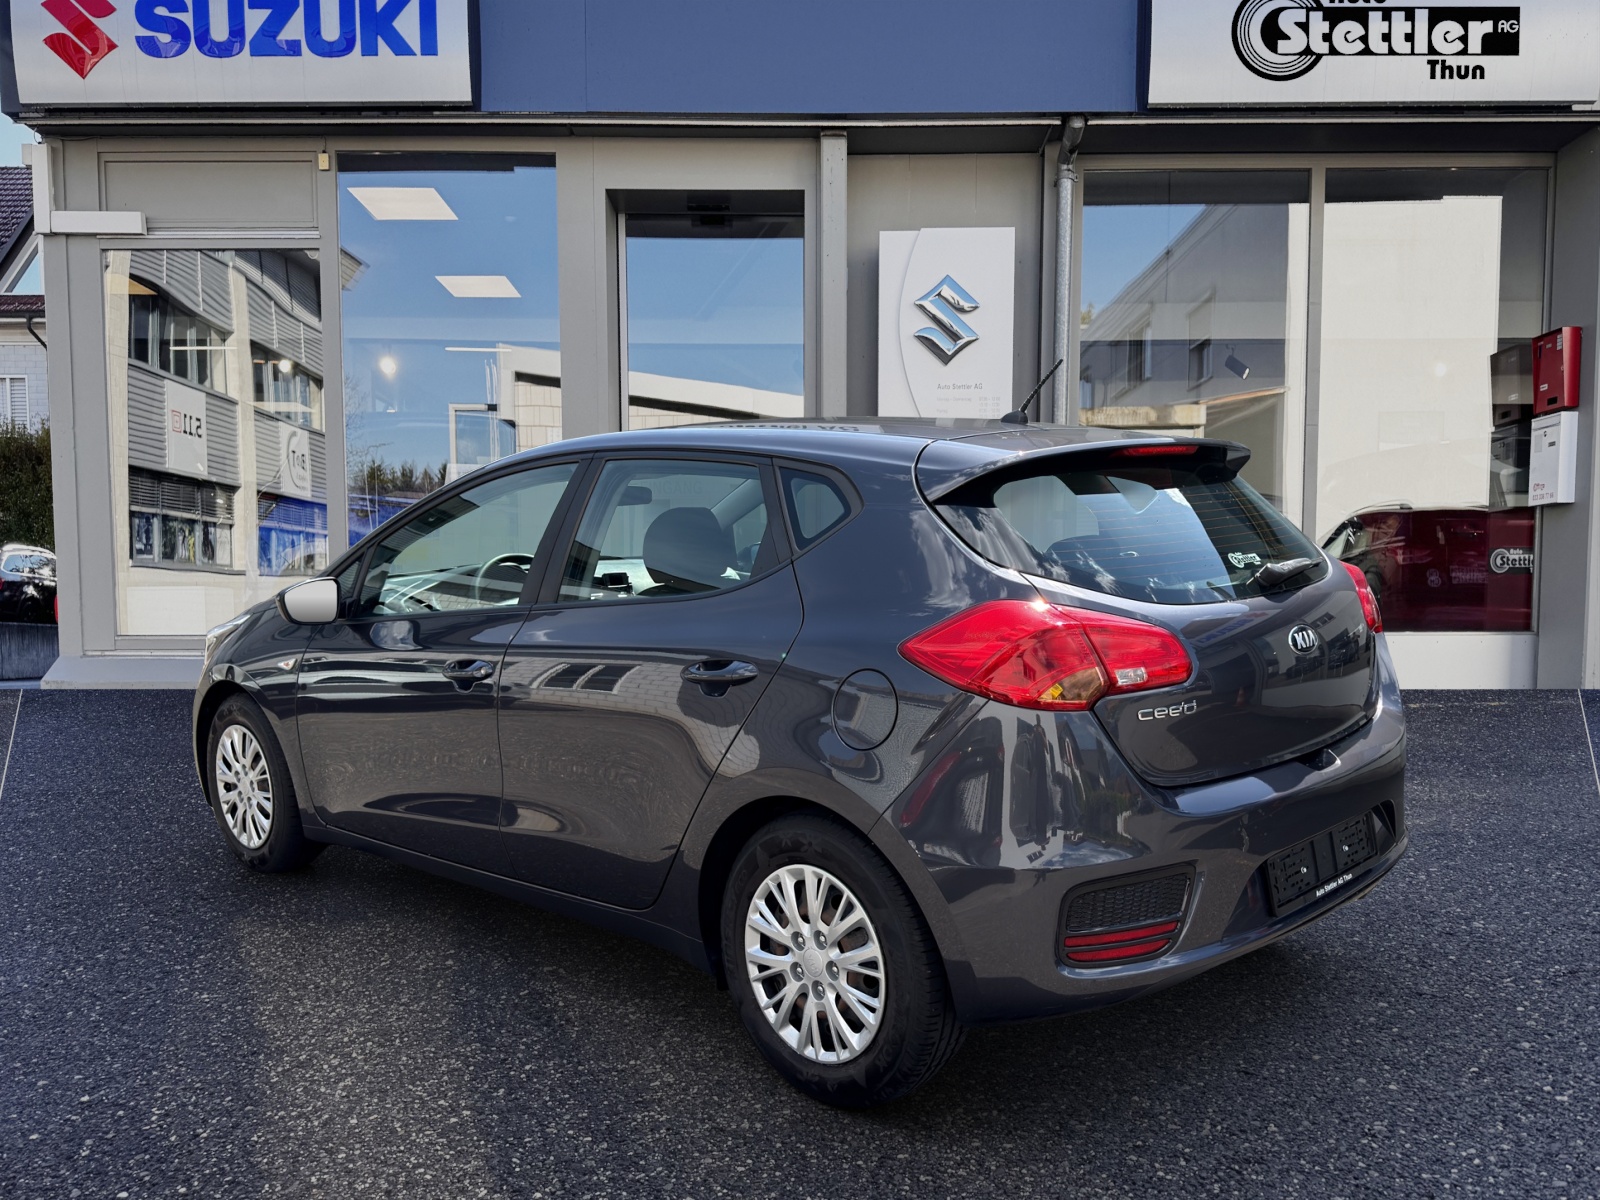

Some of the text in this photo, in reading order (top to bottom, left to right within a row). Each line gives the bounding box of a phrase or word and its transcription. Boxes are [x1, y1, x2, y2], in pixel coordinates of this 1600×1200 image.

[134, 0, 438, 58] SUZUKI
[1277, 8, 1519, 55] Stettler AG
[1426, 60, 1485, 80] Thun
[1293, 630, 1317, 649] KIA
